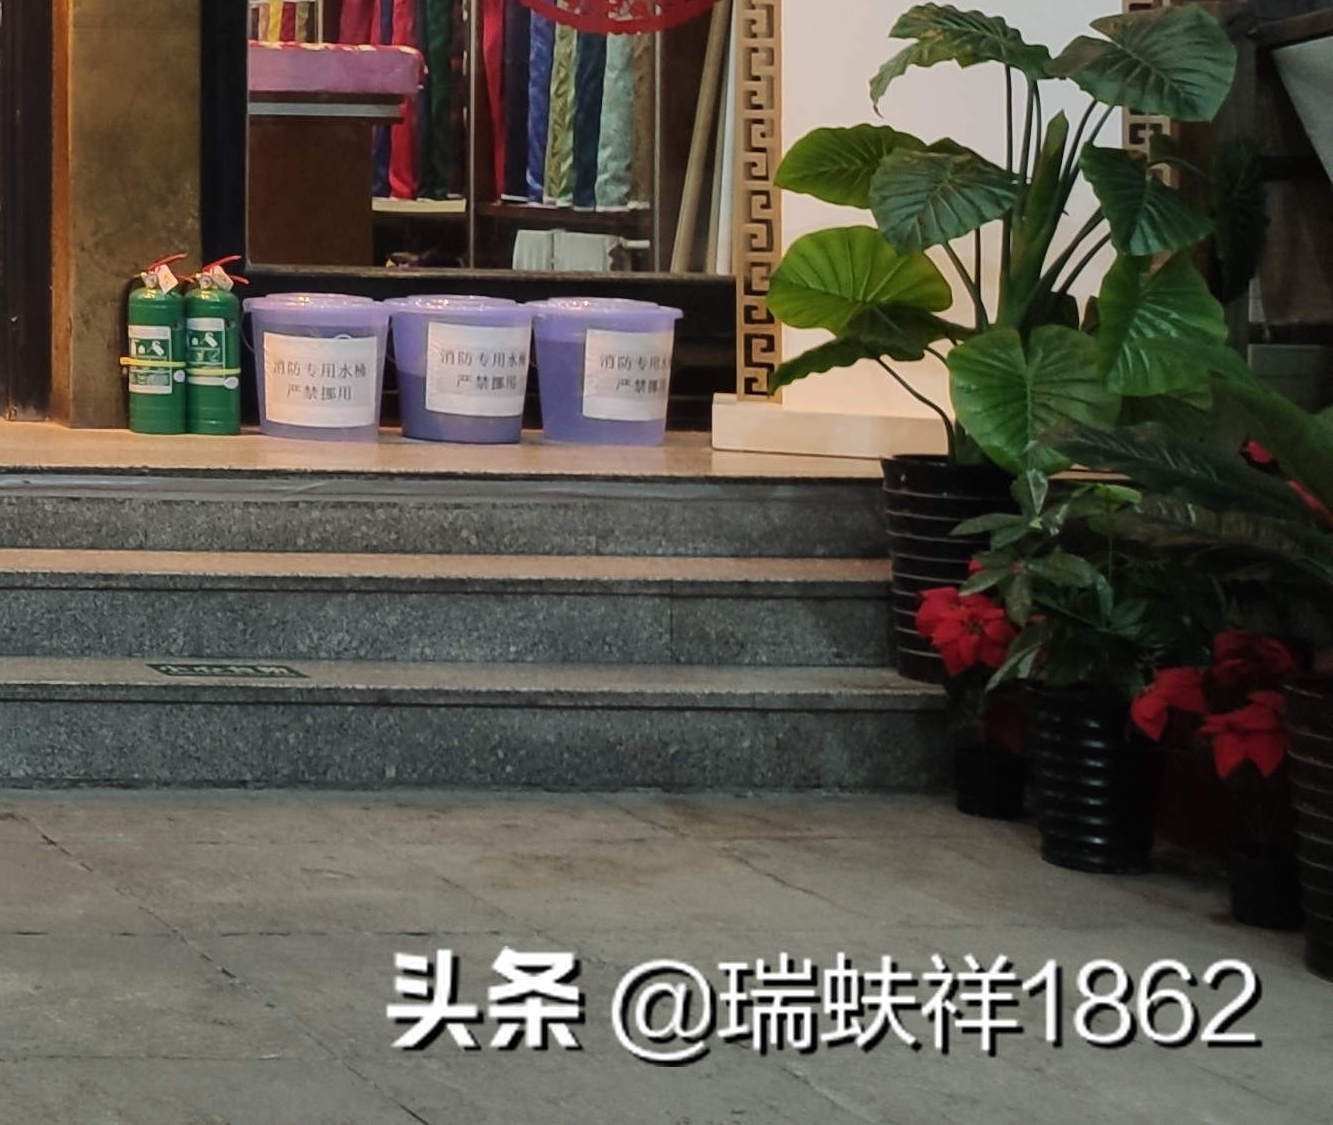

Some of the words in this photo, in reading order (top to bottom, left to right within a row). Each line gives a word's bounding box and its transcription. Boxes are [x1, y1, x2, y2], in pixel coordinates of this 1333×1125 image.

[274, 360, 367, 379] 消防专用水桶
[599, 354, 670, 372] 消防专用水
[287, 383, 352, 401] 严禁挪用
